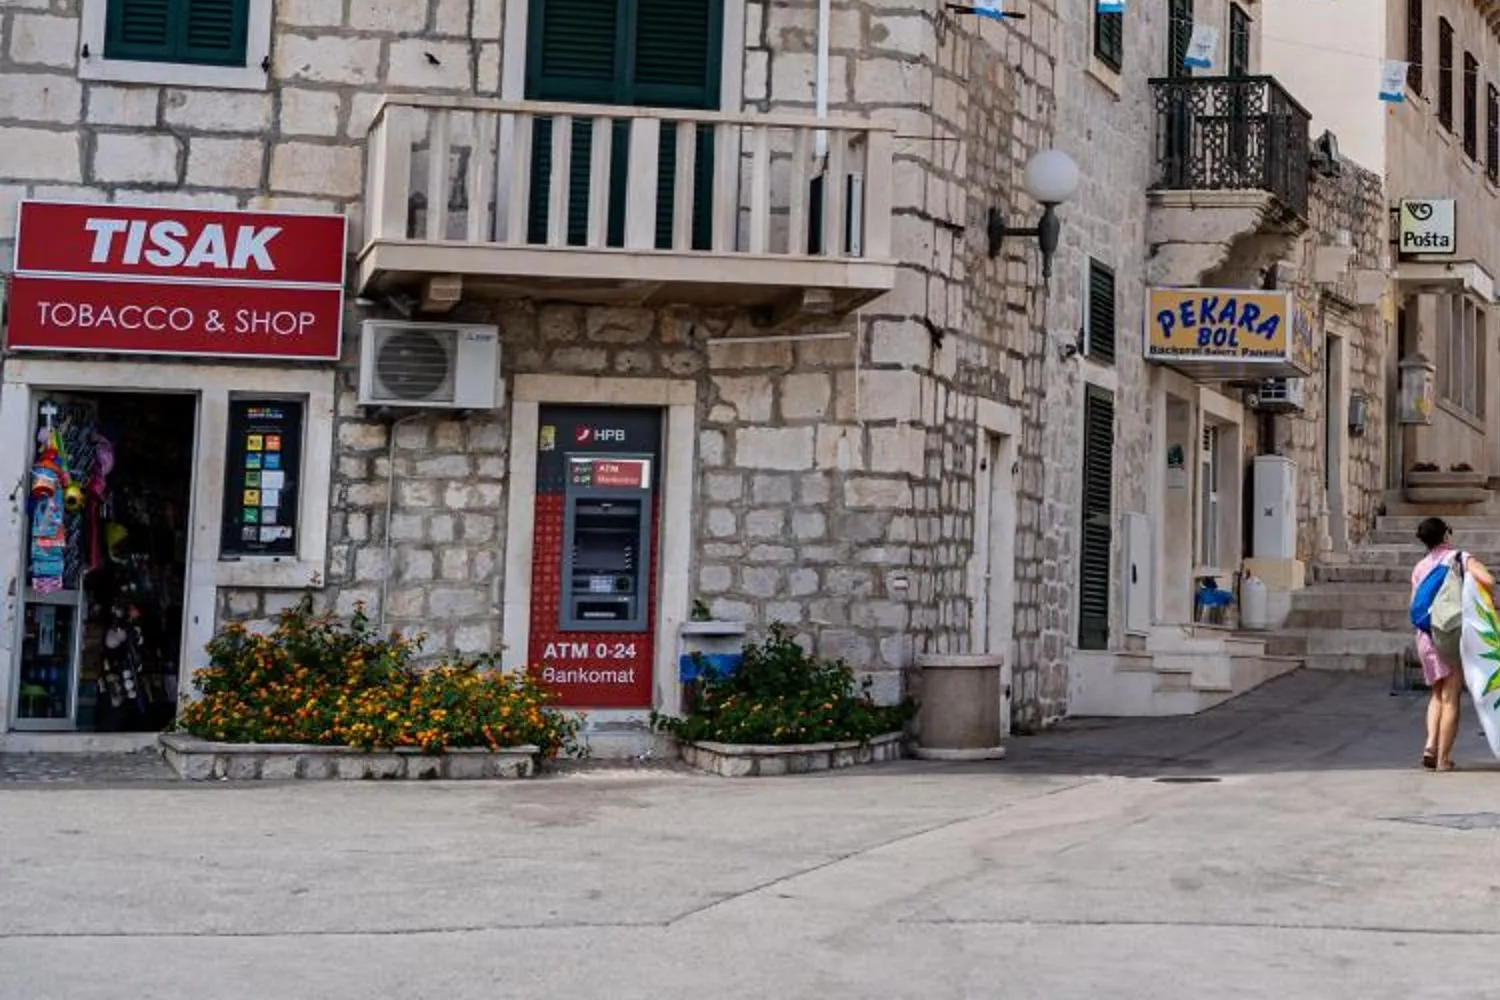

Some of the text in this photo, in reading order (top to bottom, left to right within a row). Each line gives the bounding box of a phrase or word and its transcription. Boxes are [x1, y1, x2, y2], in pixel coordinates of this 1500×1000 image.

[85, 217, 283, 271] TISAK
[1404, 231, 1449, 247] Pošta
[37, 301, 315, 335] TOBACCO & SHOP
[1157, 296, 1281, 340] PEKARA
[1197, 327, 1239, 347] BOL
[593, 429, 625, 441] HPB
[543, 643, 637, 659] ATM 0-24
[543, 667, 635, 684] Bankomat
